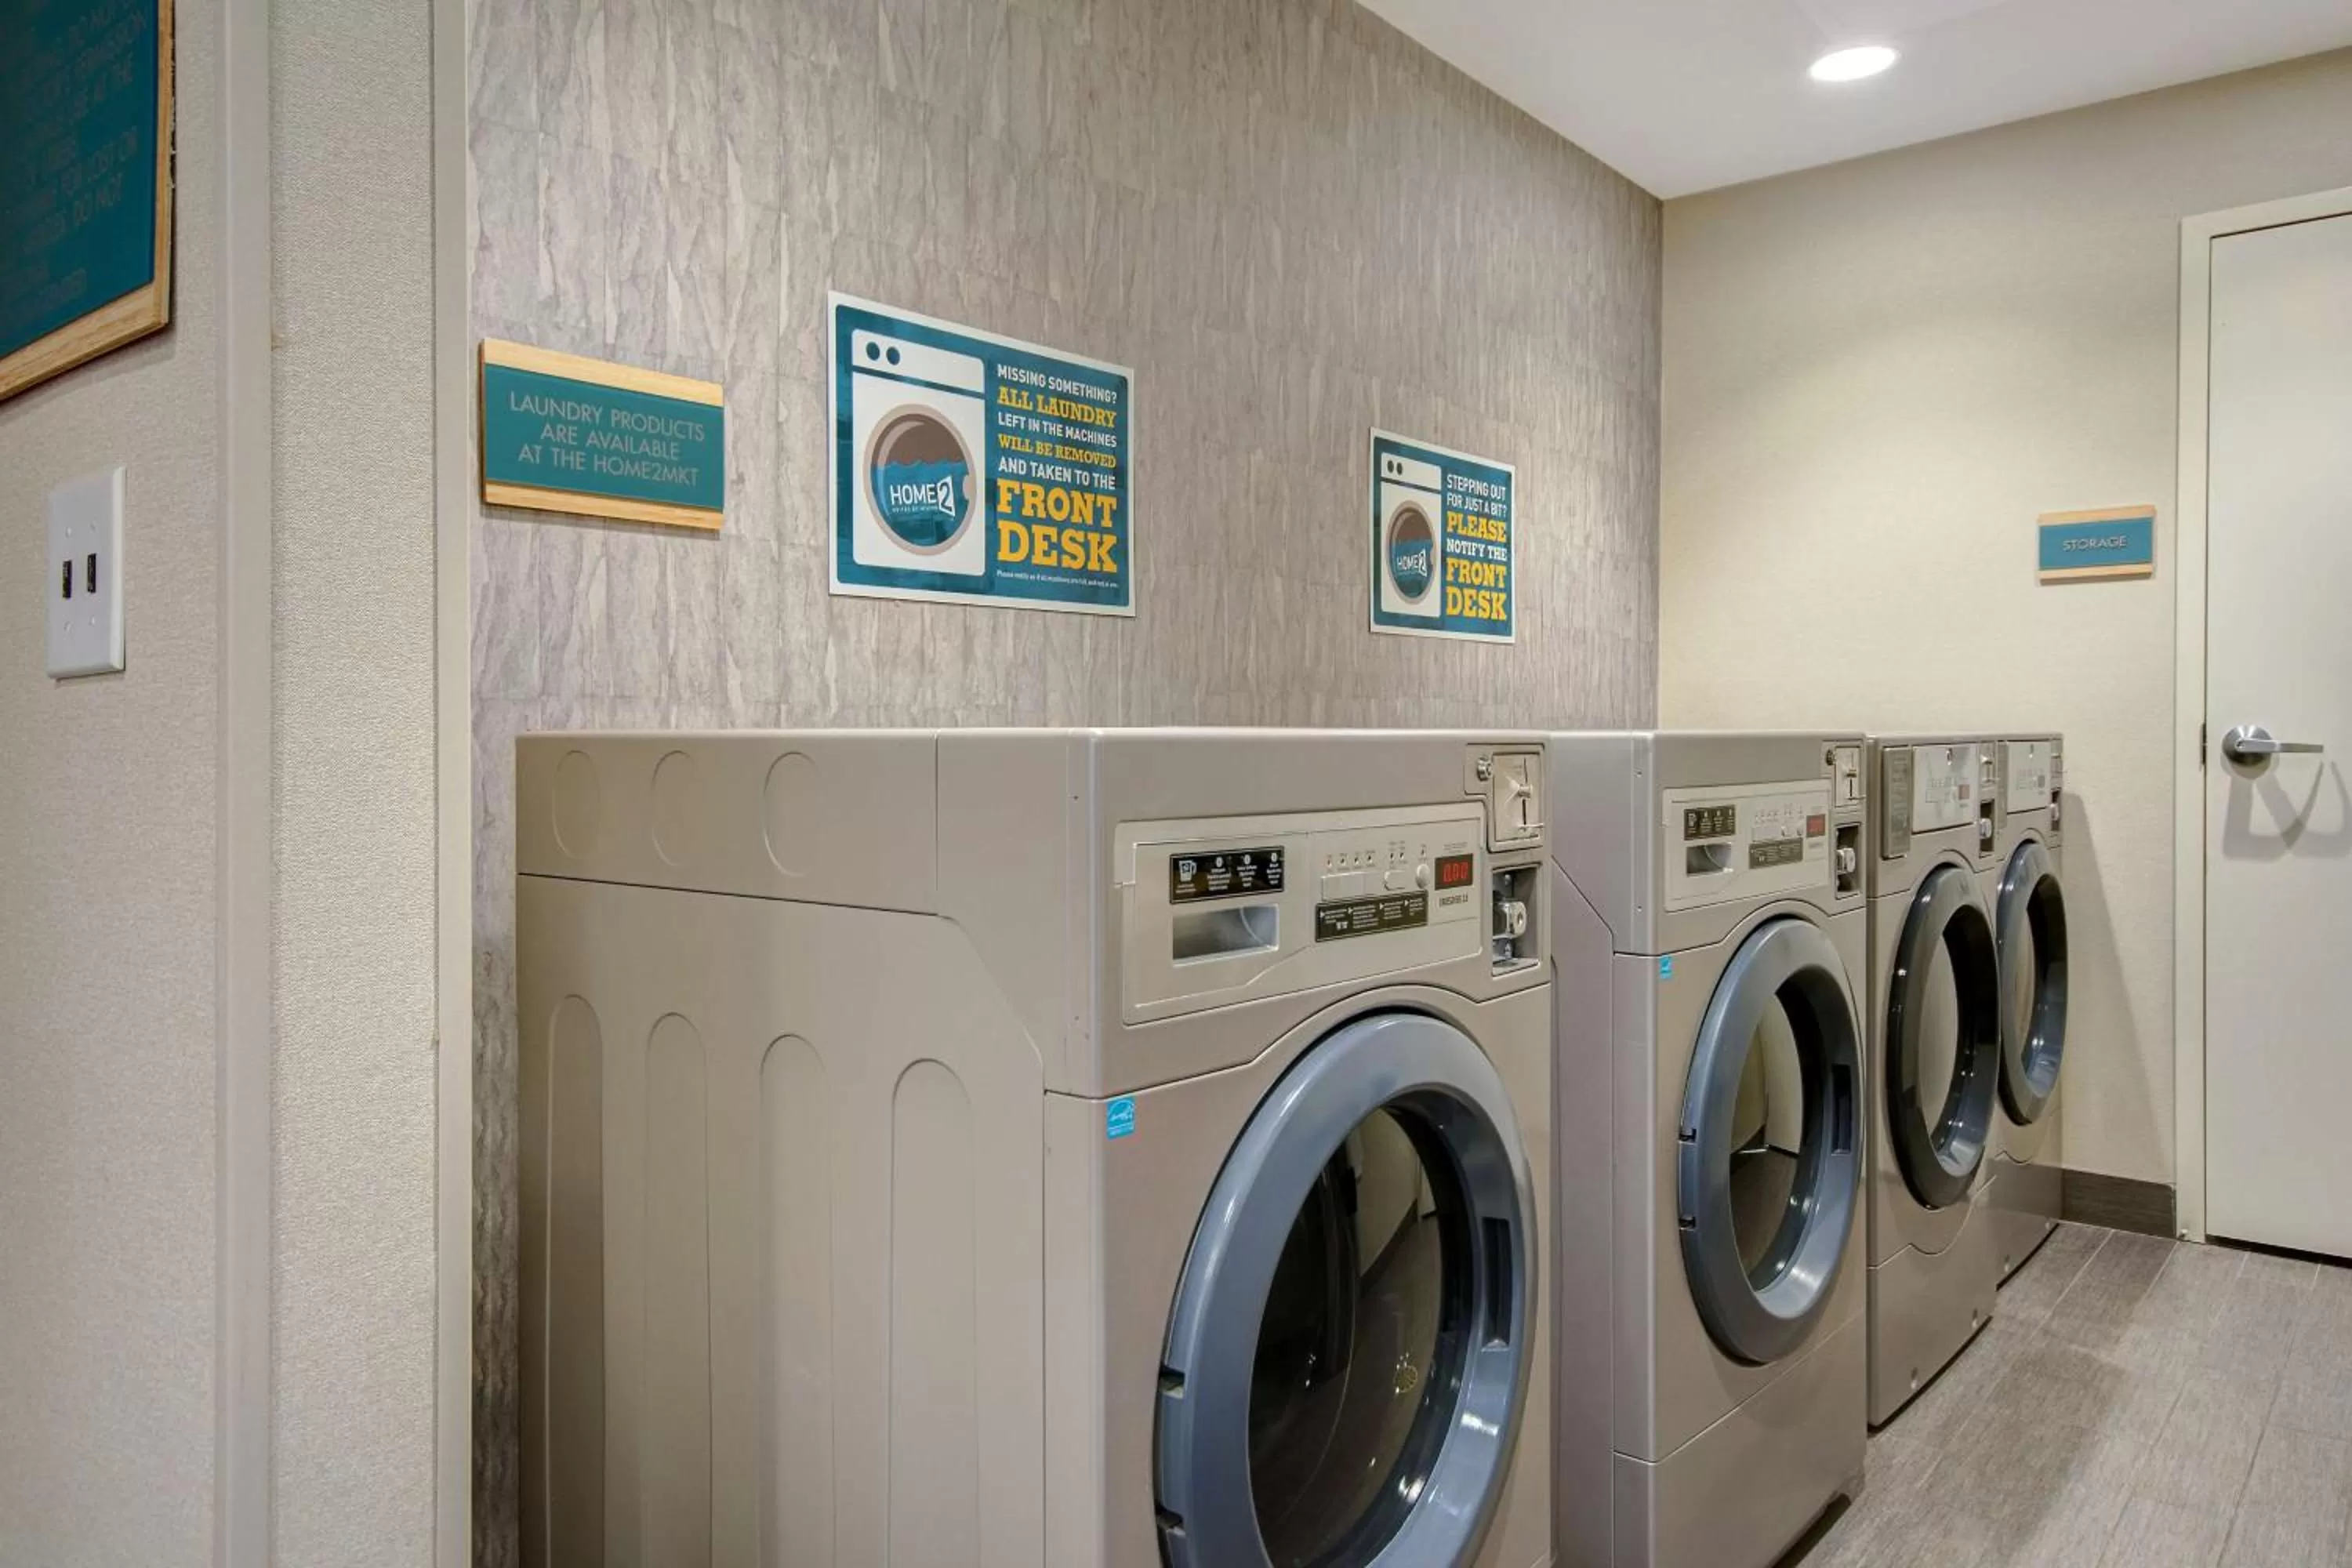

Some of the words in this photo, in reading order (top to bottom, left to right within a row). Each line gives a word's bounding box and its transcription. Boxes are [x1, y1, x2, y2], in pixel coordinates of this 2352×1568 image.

[997, 363, 1046, 388] MISSING
[1048, 378, 1117, 405] SOMETHING?
[510, 390, 603, 424] LAUNDRY
[611, 408, 705, 441] PRODUCTS
[997, 386, 1033, 411] ALL
[1036, 394, 1116, 428] LAUNDRY
[540, 423, 578, 446] ARE
[586, 430, 680, 461] AVAILABLE
[998, 412, 1026, 430] LEFT
[1028, 418, 1040, 432] IN
[1043, 420, 1063, 437] THE
[1065, 426, 1117, 448] MACHINES
[518, 443, 543, 464] AT
[551, 447, 586, 470] THE
[593, 454, 699, 486] HOME2MKT
[997, 433, 1033, 453] WILL
[1035, 440, 1054, 458] BE
[1054, 444, 1116, 469] REMOVED
[998, 456, 1027, 475] AND
[1030, 461, 1072, 484] TAKEN
[1074, 470, 1090, 487] TO
[1092, 473, 1116, 490] THE
[1446, 474, 1489, 496] STEPPING
[1490, 485, 1506, 502] OUT
[996, 477, 1117, 528] FRONT
[1446, 492, 1462, 509] FOR
[1464, 496, 1483, 512] JUST
[1483, 501, 1490, 515] A
[1446, 510, 1507, 543] PLEASE
[2062, 535, 2127, 551] STORAGE
[996, 520, 1117, 573] DESK
[1446, 539, 1486, 557] NOTIFY
[1487, 546, 1507, 562] THE
[1446, 557, 1507, 588] FRONT
[1446, 586, 1507, 621] DESK
